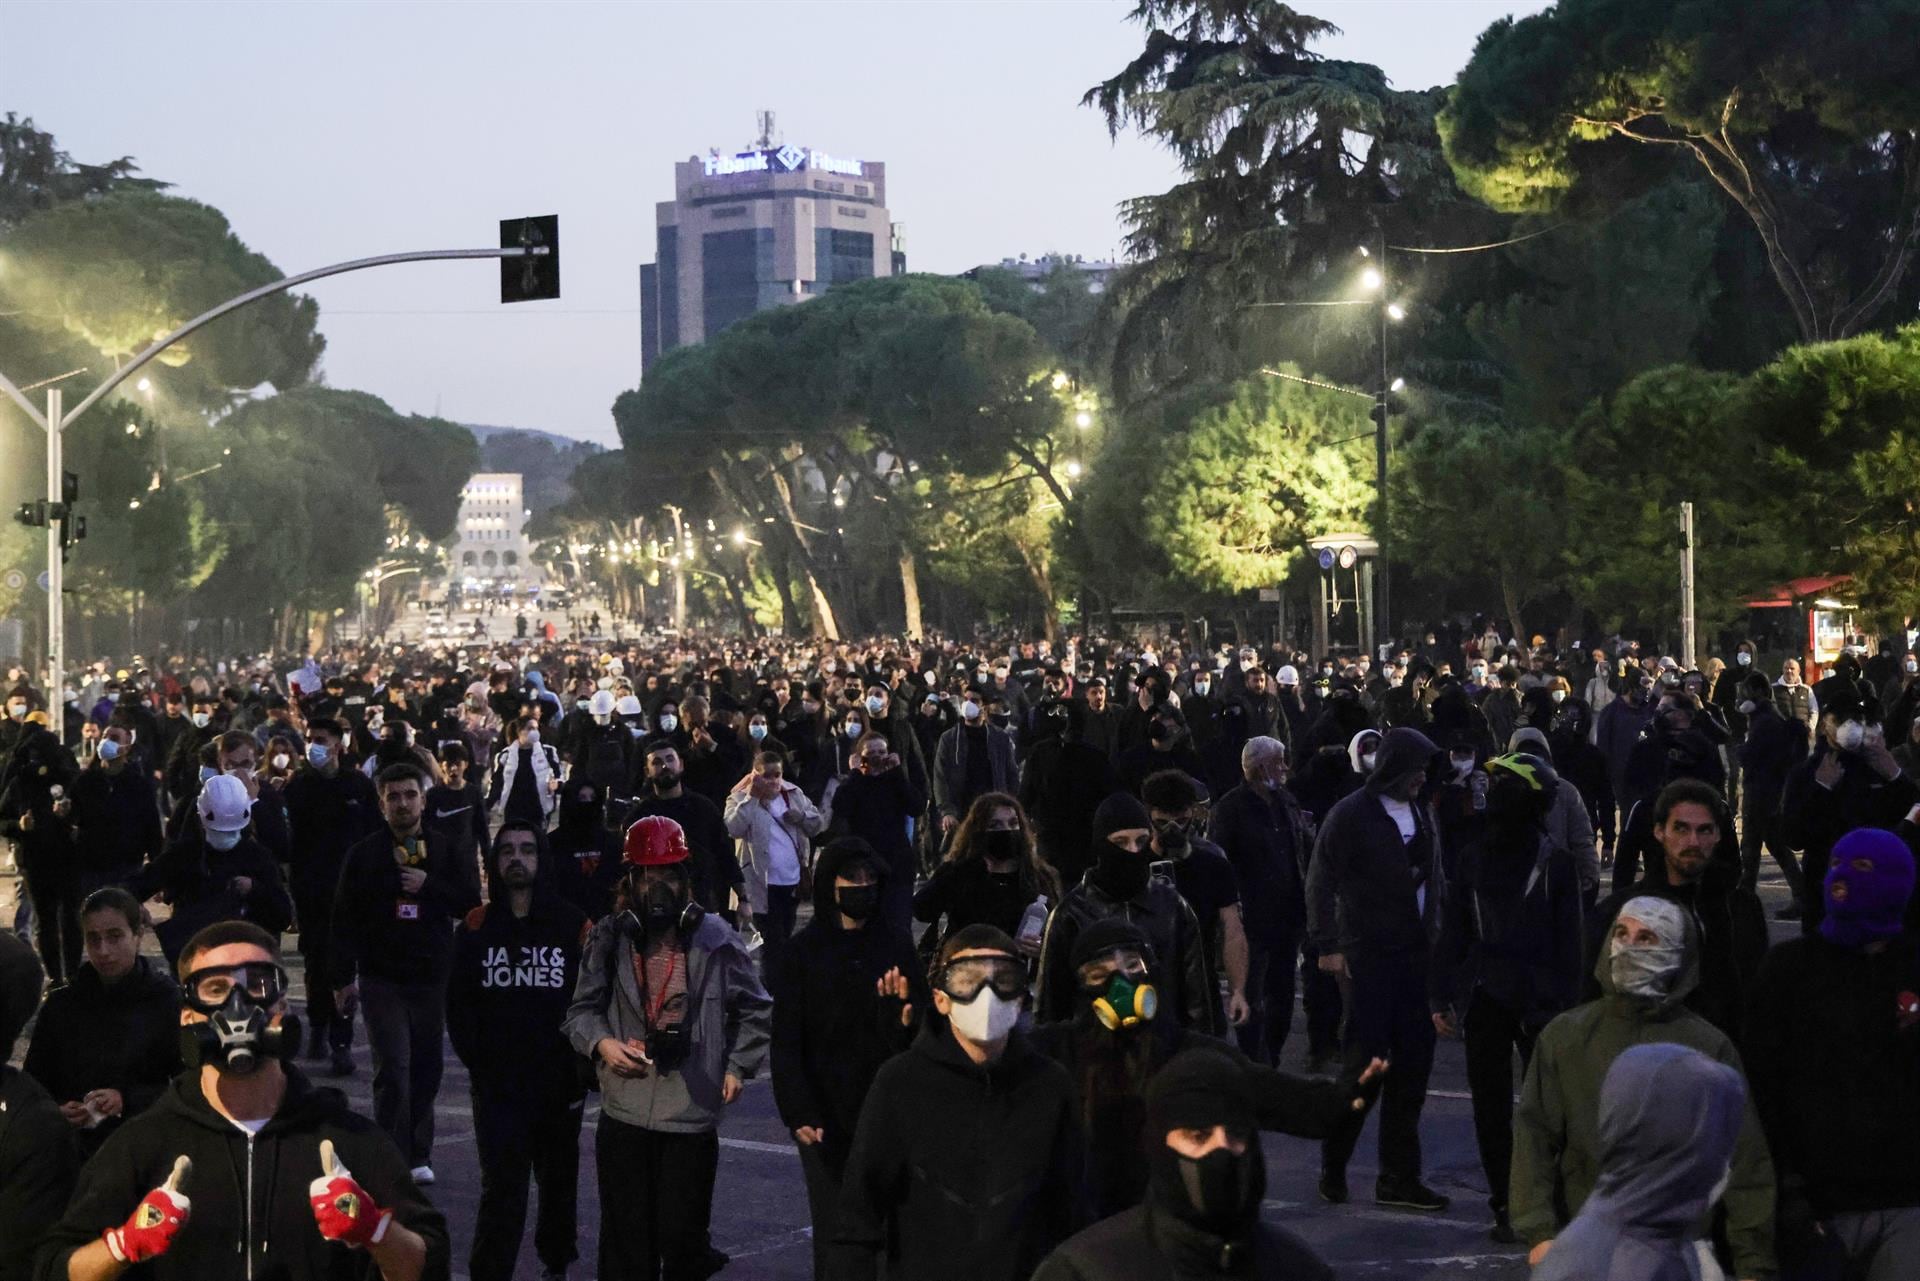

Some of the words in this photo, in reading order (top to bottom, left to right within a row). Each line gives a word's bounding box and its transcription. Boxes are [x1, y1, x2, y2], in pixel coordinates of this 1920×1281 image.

[705, 152, 768, 176] Fibank
[811, 150, 863, 176] Fibank
[482, 966, 565, 988] JONES
